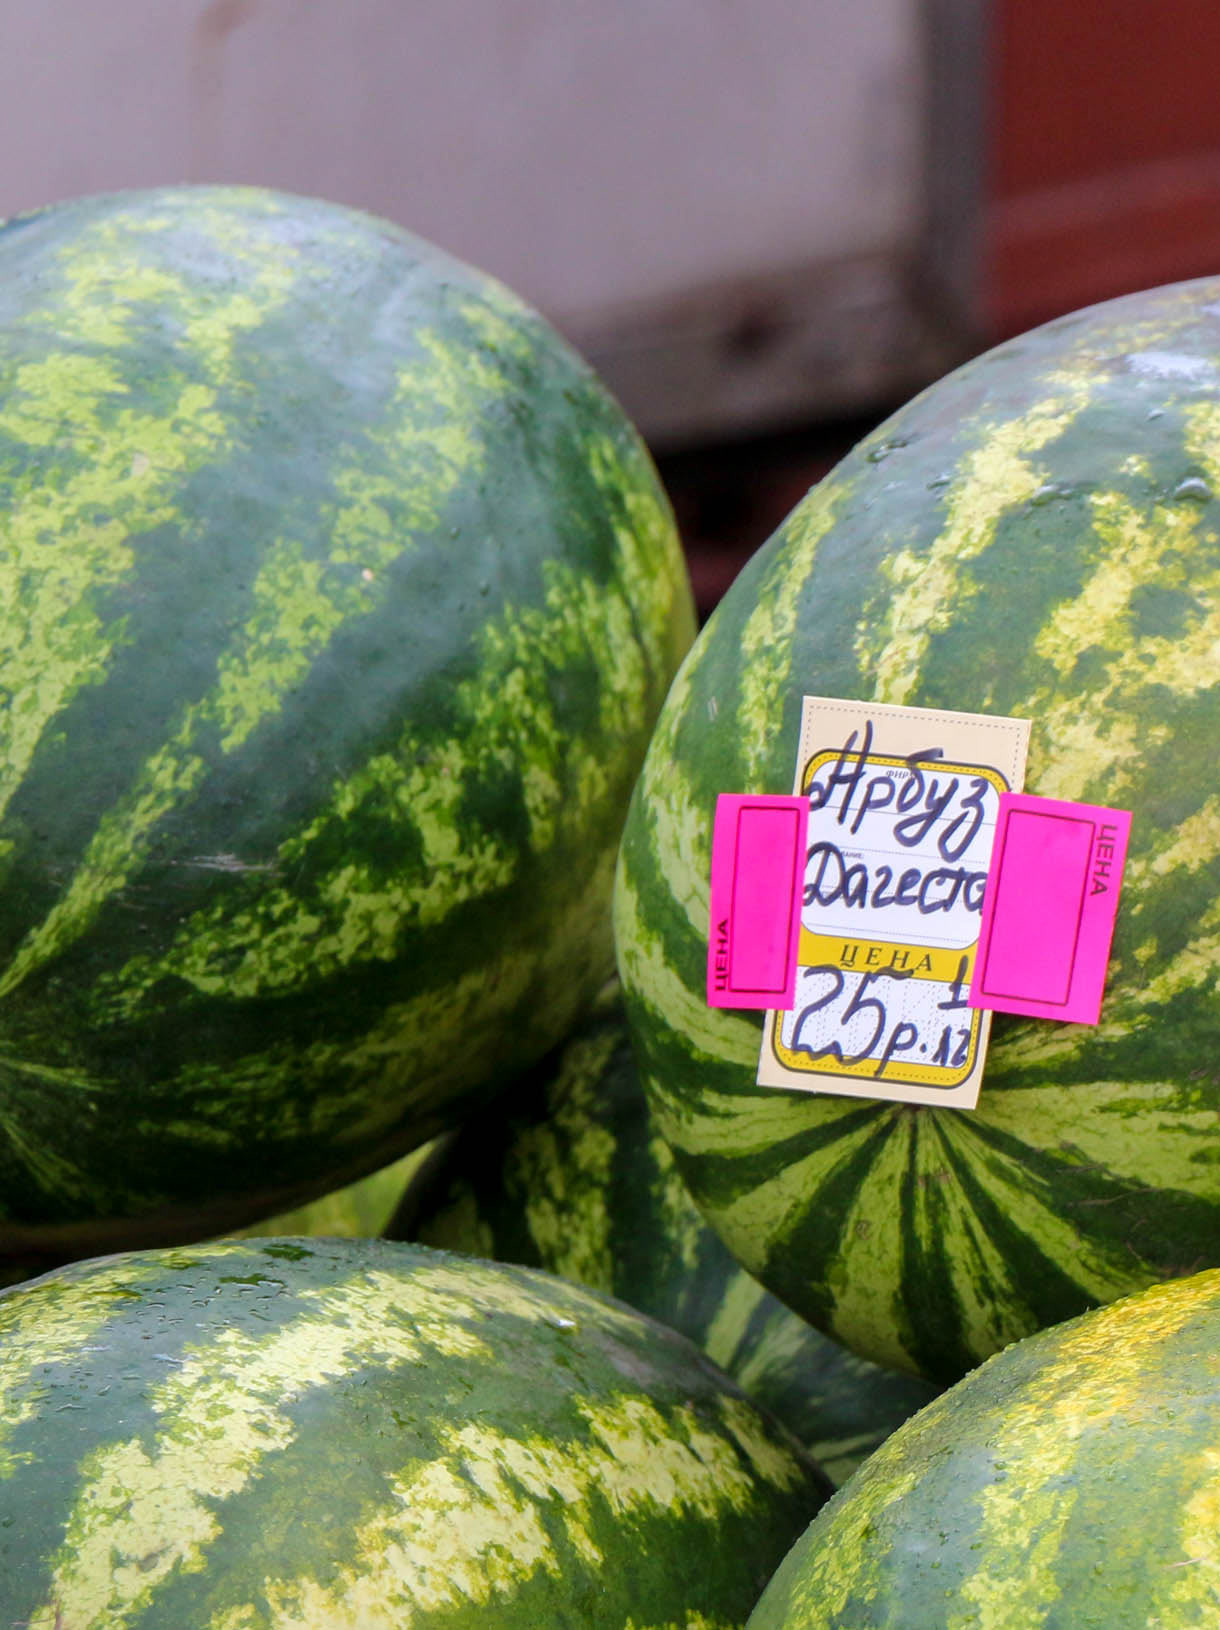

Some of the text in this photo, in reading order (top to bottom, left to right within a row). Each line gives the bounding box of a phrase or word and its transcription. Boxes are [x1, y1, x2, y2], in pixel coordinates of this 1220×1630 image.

[1090, 824, 1118, 896] ЦЕНА
[715, 919, 729, 991] ЦЕНА
[840, 944, 933, 972] ЦЕНА
